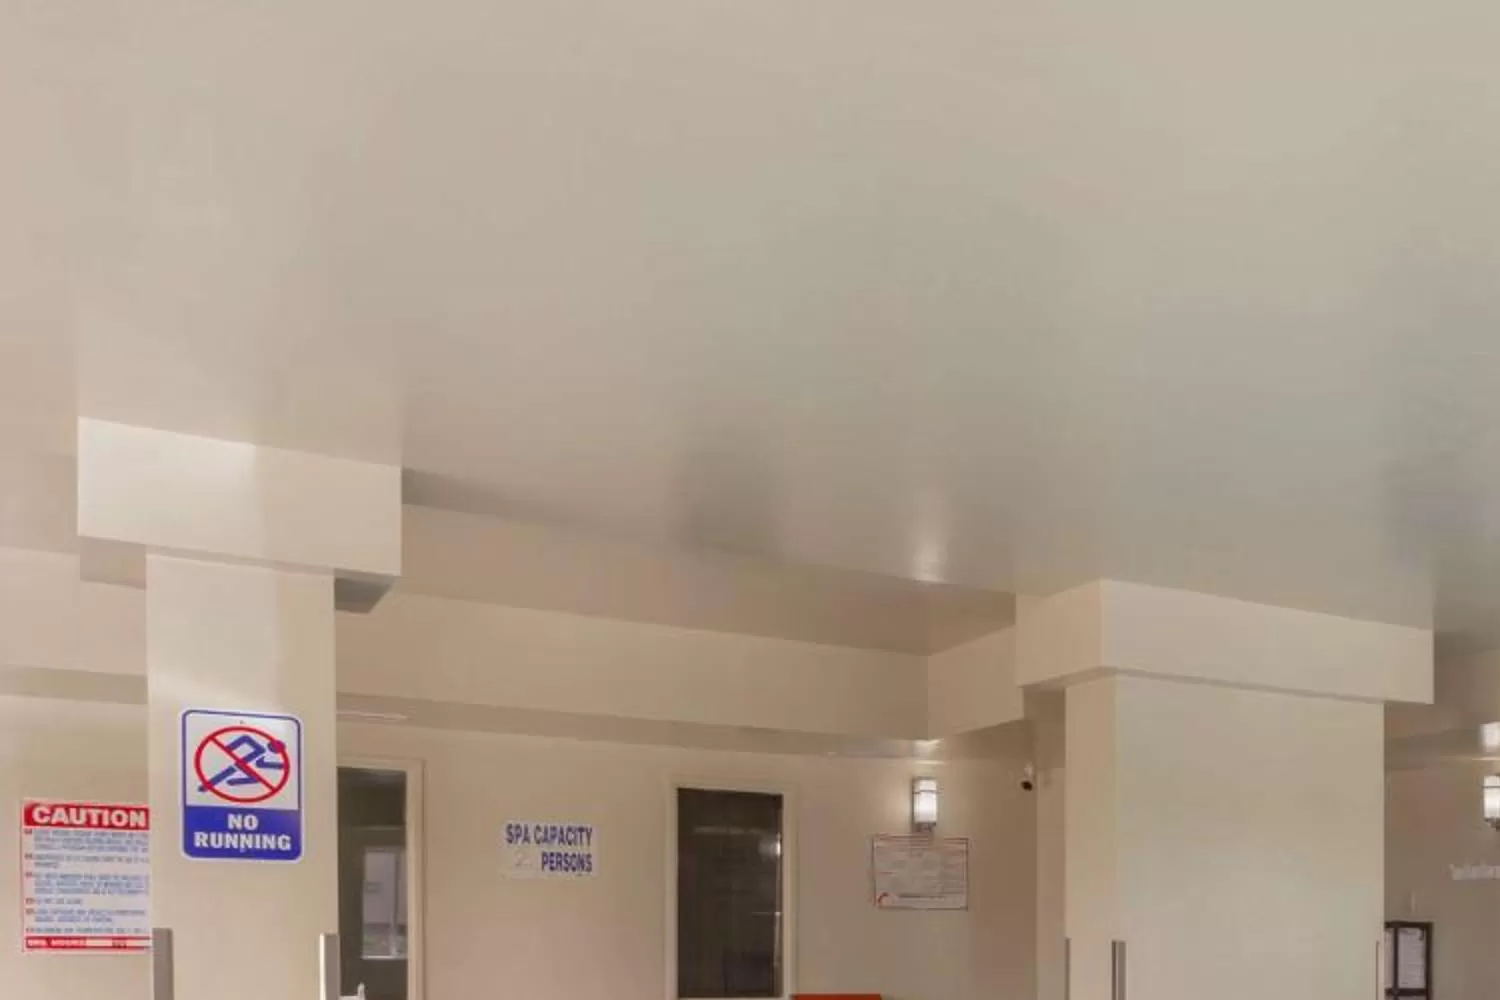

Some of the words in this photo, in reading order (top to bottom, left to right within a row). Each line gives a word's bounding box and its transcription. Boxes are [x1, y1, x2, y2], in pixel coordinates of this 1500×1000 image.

[32, 804, 148, 828] CAUTION
[227, 812, 259, 830] NO
[194, 831, 292, 851] RUNNING
[505, 823, 531, 845] SPA
[534, 823, 593, 847] CAPACITY
[541, 851, 593, 873] PERSONS
